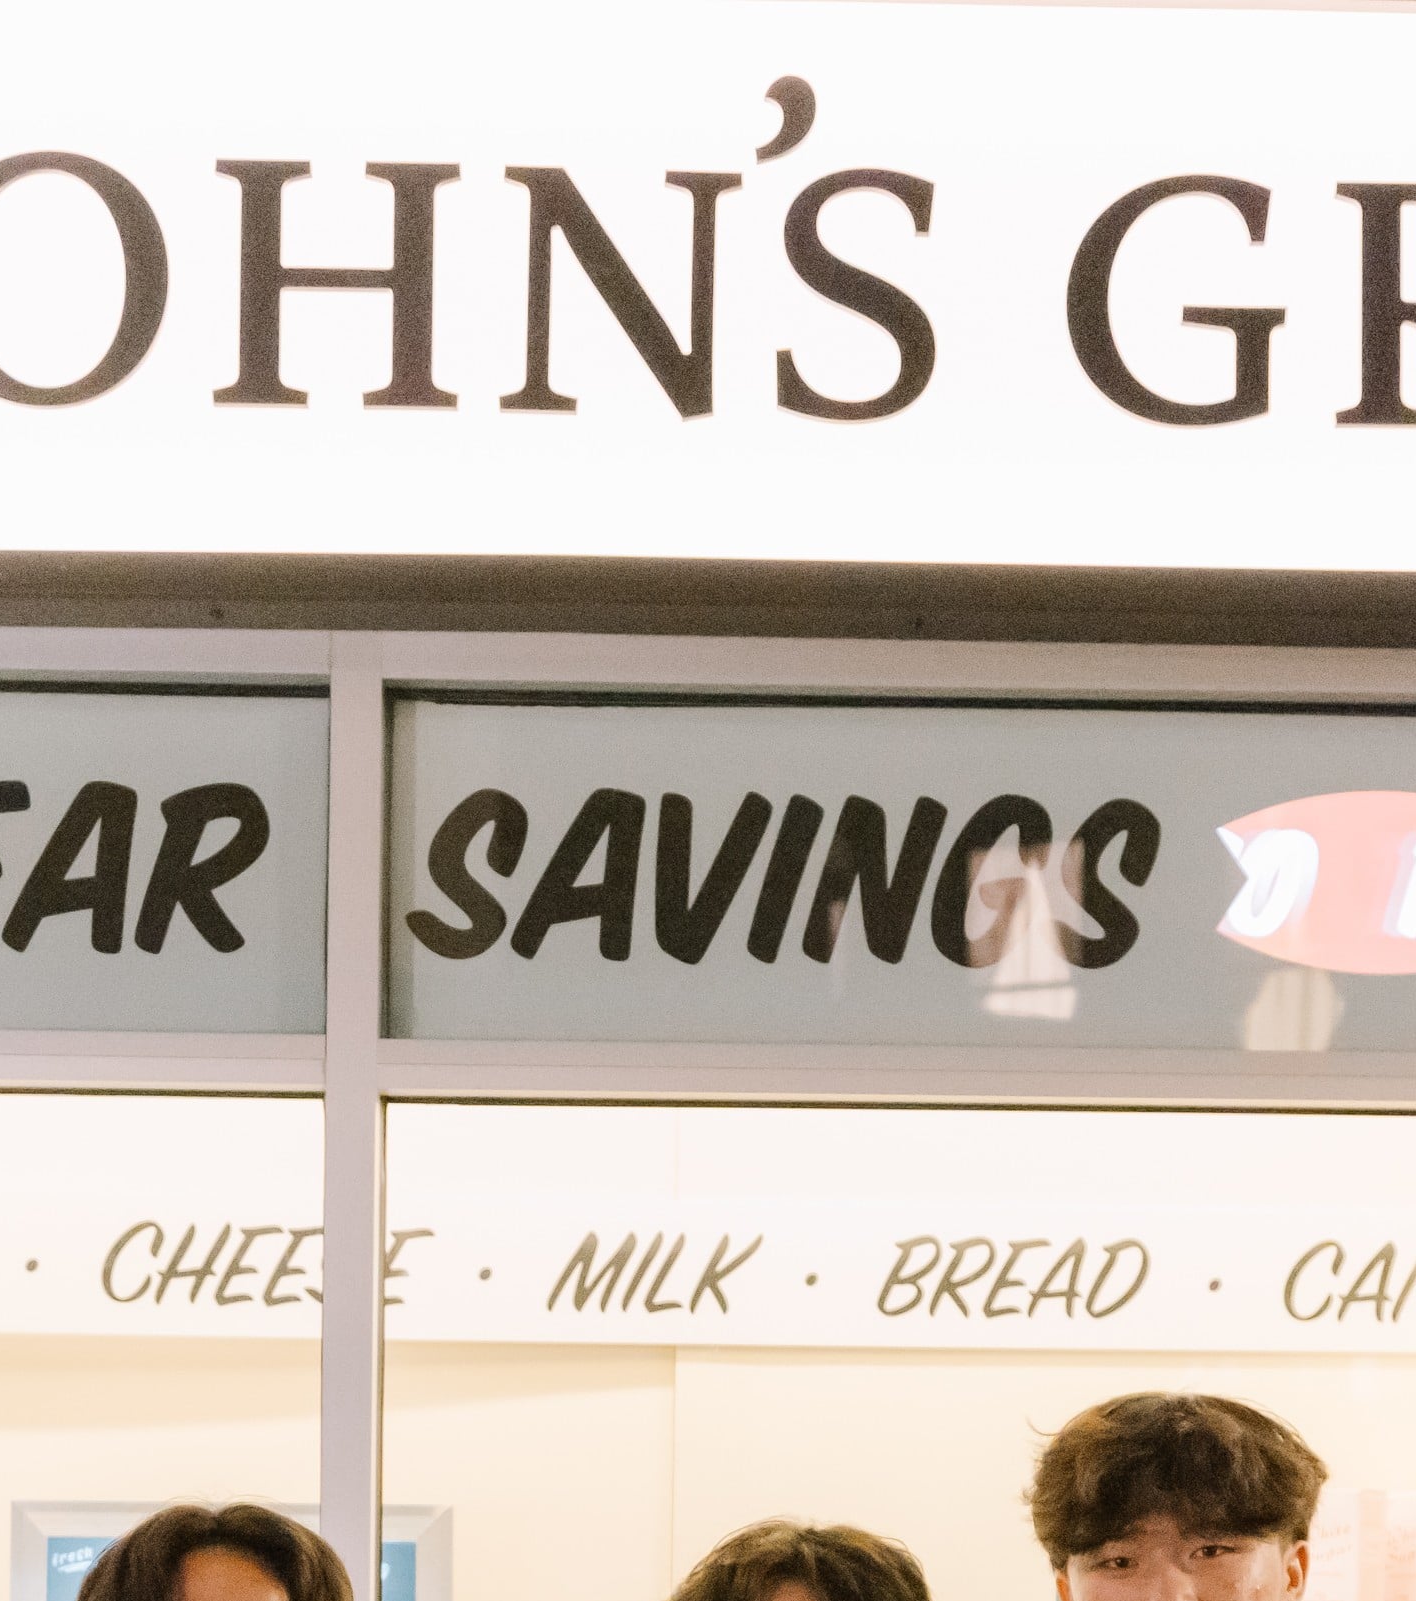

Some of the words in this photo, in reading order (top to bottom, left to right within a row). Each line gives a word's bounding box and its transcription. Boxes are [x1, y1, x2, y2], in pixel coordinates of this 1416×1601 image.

[405, 787, 1161, 970] SAVINGS
[99, 1219, 436, 1307] CHEEE
[546, 1231, 764, 1318] MILK
[876, 1236, 1151, 1321] BREAD
